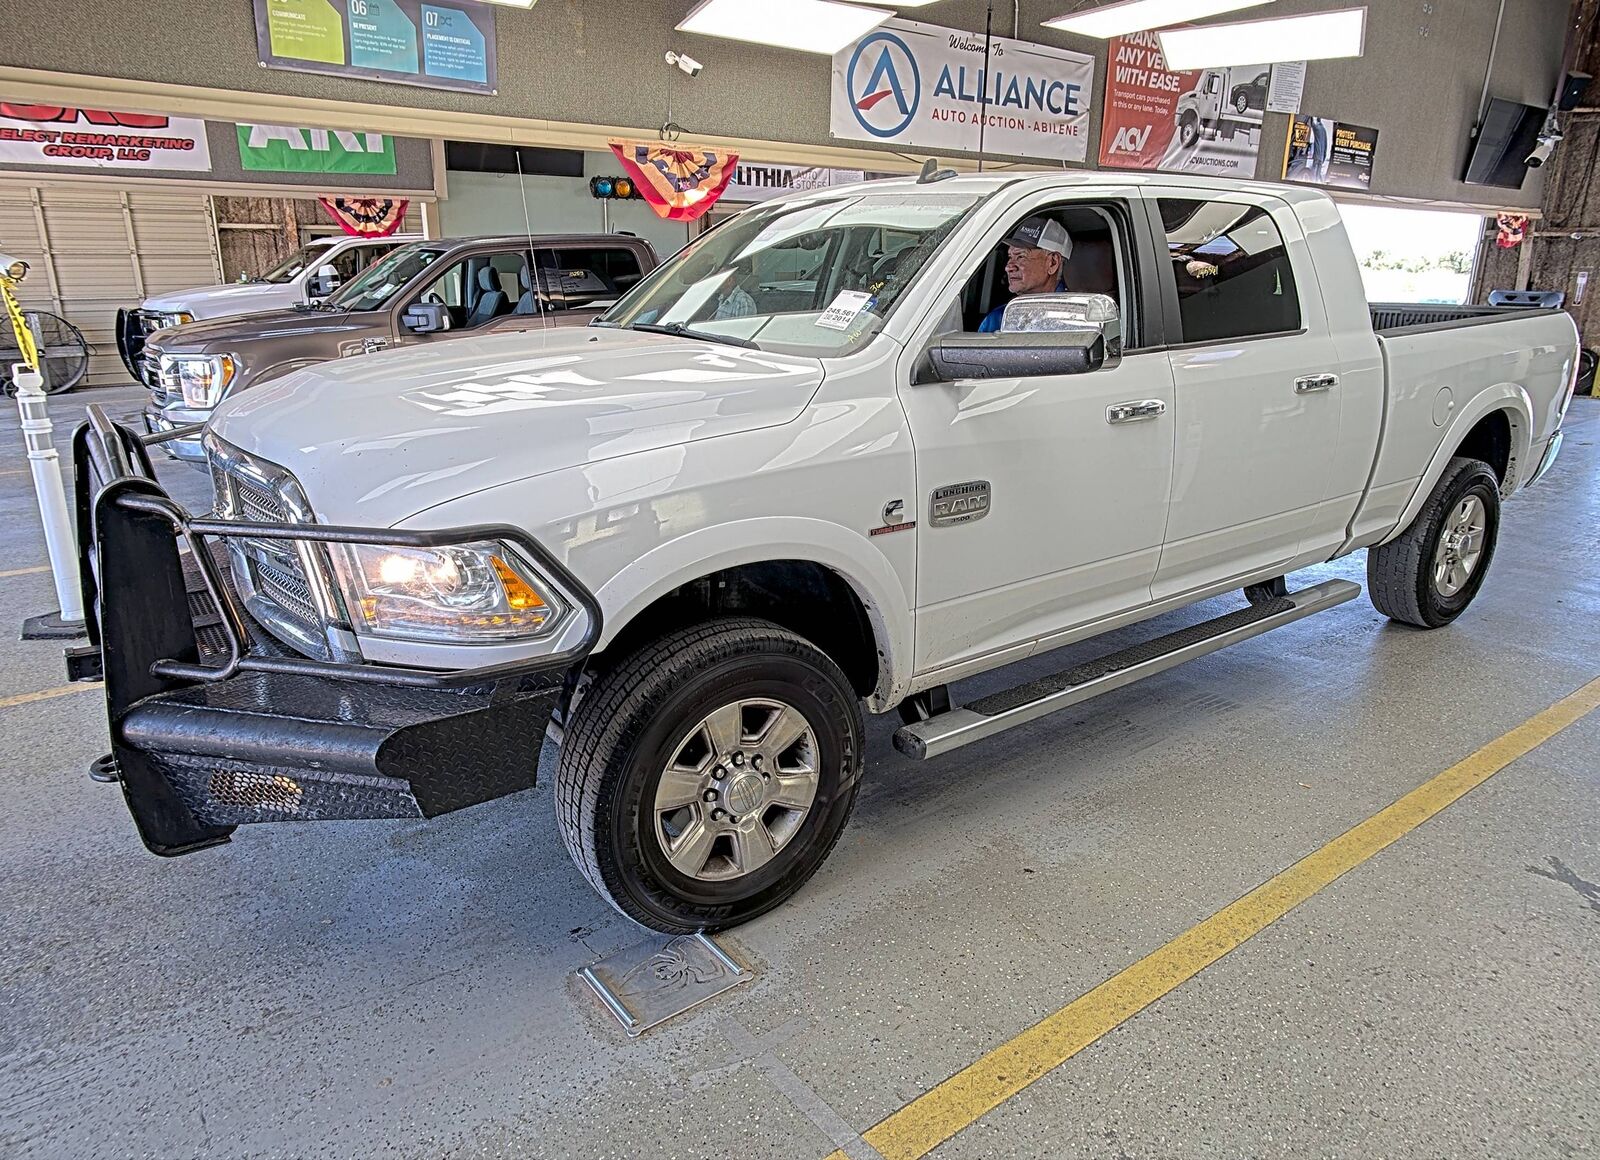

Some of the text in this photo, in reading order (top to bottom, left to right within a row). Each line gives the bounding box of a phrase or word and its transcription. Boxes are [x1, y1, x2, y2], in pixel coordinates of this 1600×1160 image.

[351, 0, 367, 15] 06
[426, 11, 438, 26] 07
[1120, 31, 1160, 49] RANS
[993, 43, 1004, 56] To
[1115, 46, 1145, 66] ANY
[1115, 66, 1180, 92] WITH EASE.
[933, 63, 1081, 116] ALLIANCE
[1114, 89, 1135, 99] Transport
[1146, 96, 1171, 105] purchased
[1118, 101, 1127, 109] this
[1133, 104, 1142, 112] any
[1154, 105, 1169, 115] Today.
[931, 108, 966, 123] AUTO
[971, 113, 1025, 130] AUCTION
[1033, 121, 1078, 137] ABILENE
[0, 128, 195, 150] ELECT REMARKETING
[1108, 125, 1153, 154] ACV
[1336, 129, 1356, 140] PROTECT
[1335, 138, 1350, 148] EVERY
[43, 144, 152, 161] GROUP, LLC
[737, 166, 794, 189] LITHIA
[795, 179, 827, 190] STORES
[798, 172, 818, 181] AUTO
[832, 315, 852, 323] 2014
[934, 495, 988, 517] RAM
